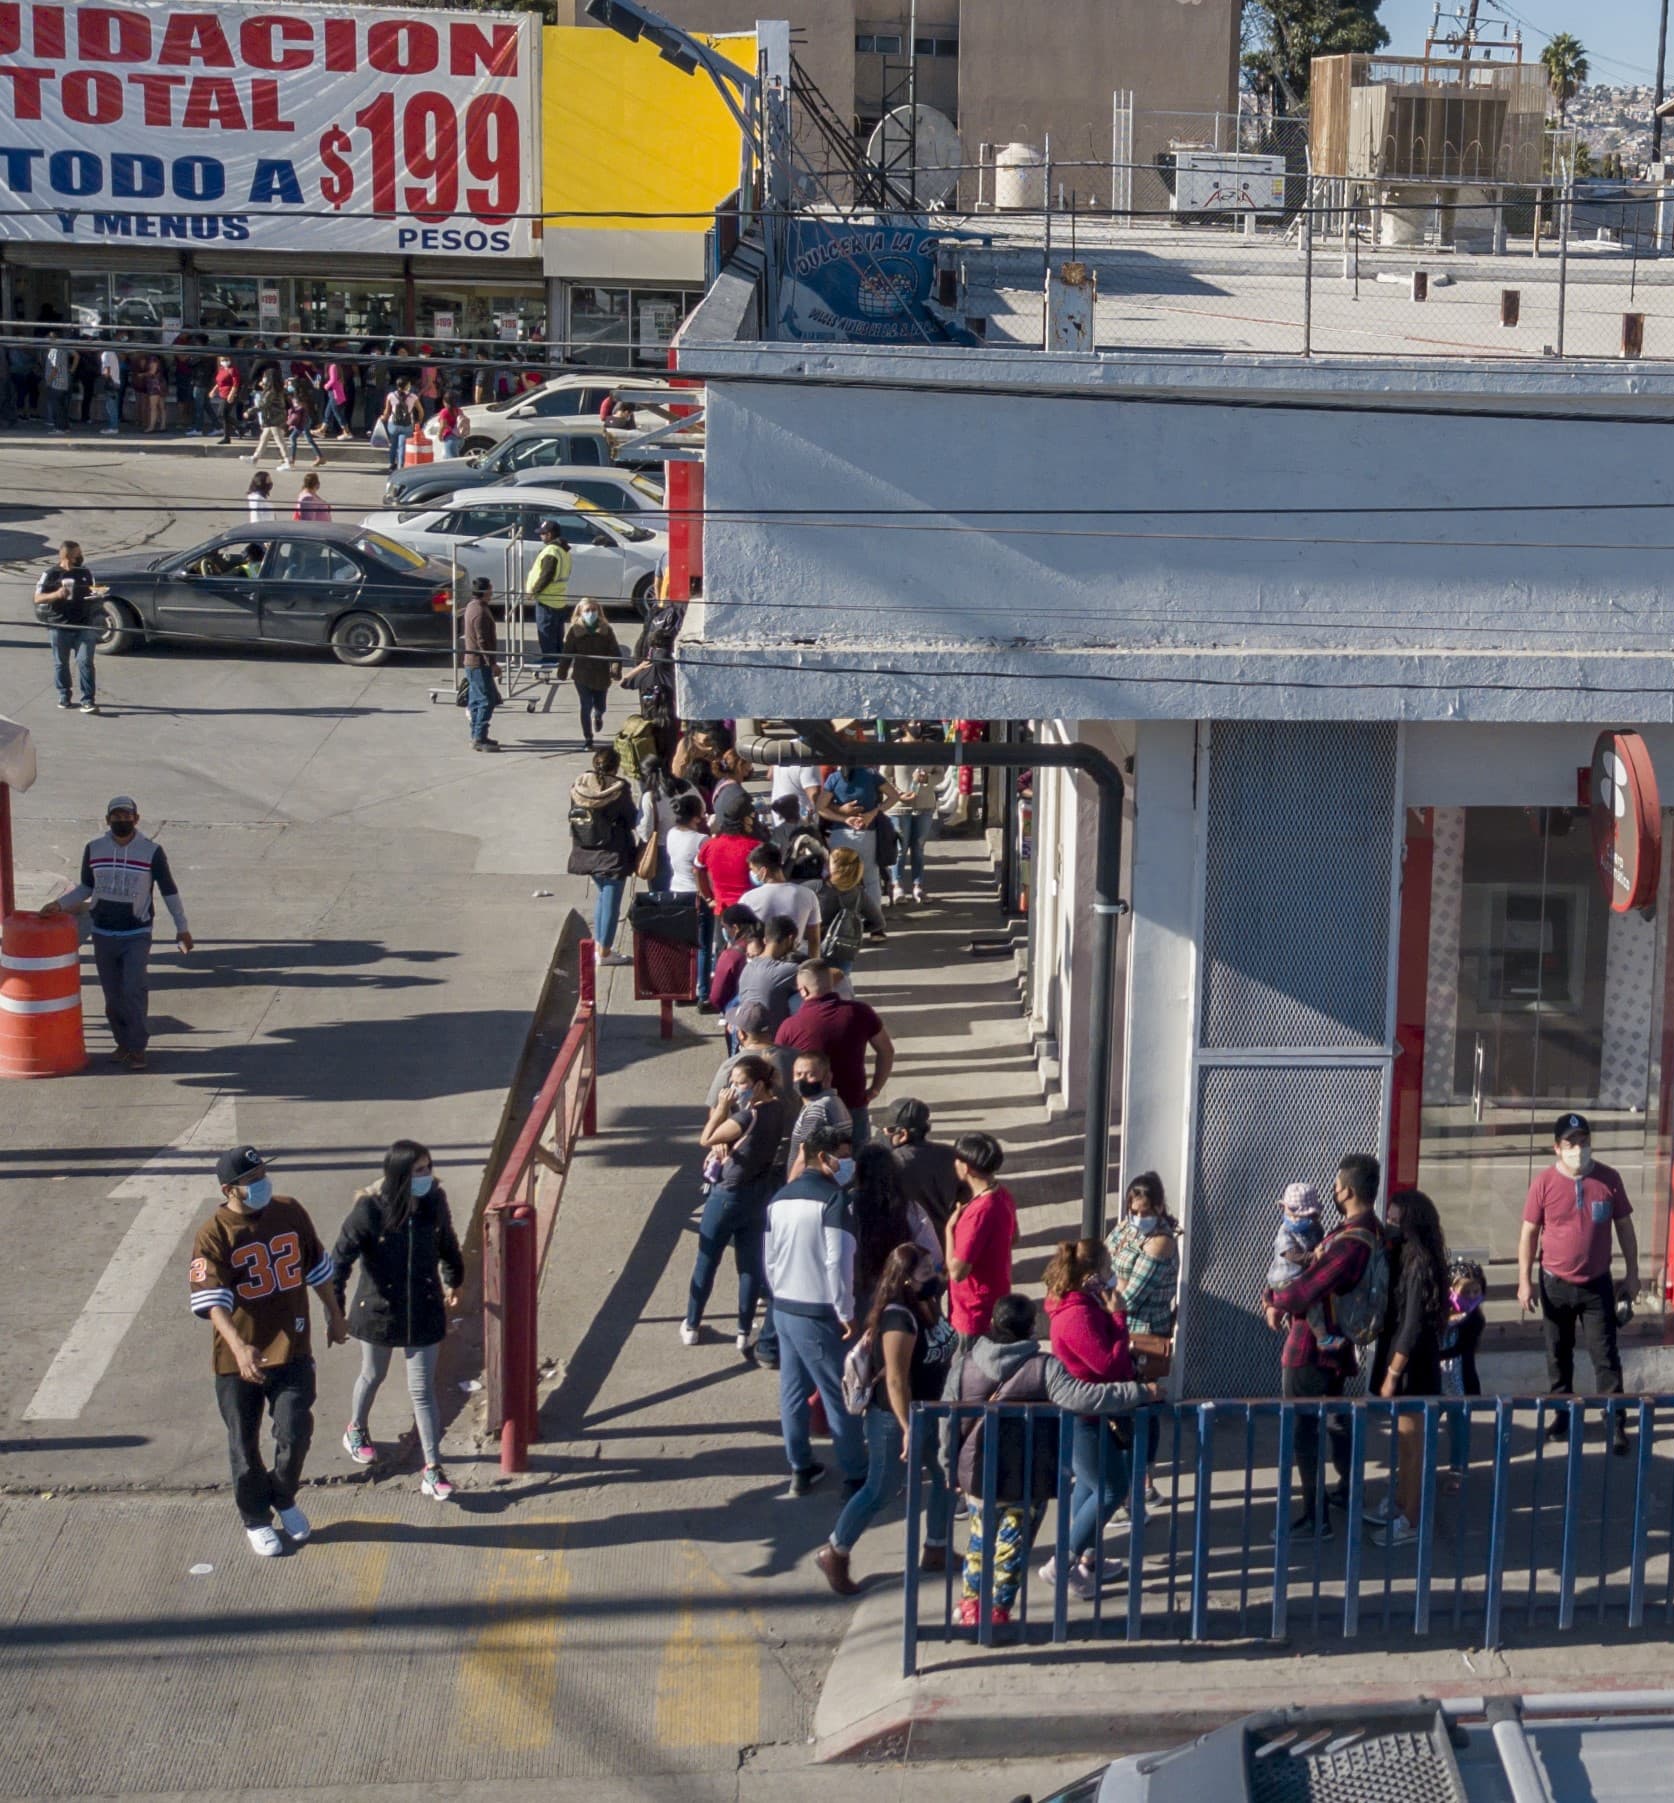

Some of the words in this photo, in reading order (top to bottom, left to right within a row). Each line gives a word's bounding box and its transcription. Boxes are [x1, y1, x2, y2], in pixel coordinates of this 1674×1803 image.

[0, 66, 295, 132] TOTAL
[0, 147, 225, 201] TODO
[248, 159, 304, 203] A
[319, 91, 521, 226] $199
[56, 207, 80, 233] Y
[94, 213, 250, 241] MENOS
[398, 228, 511, 251] PESOS
[890, 231, 915, 251] LA
[231, 1232, 302, 1299] 32
